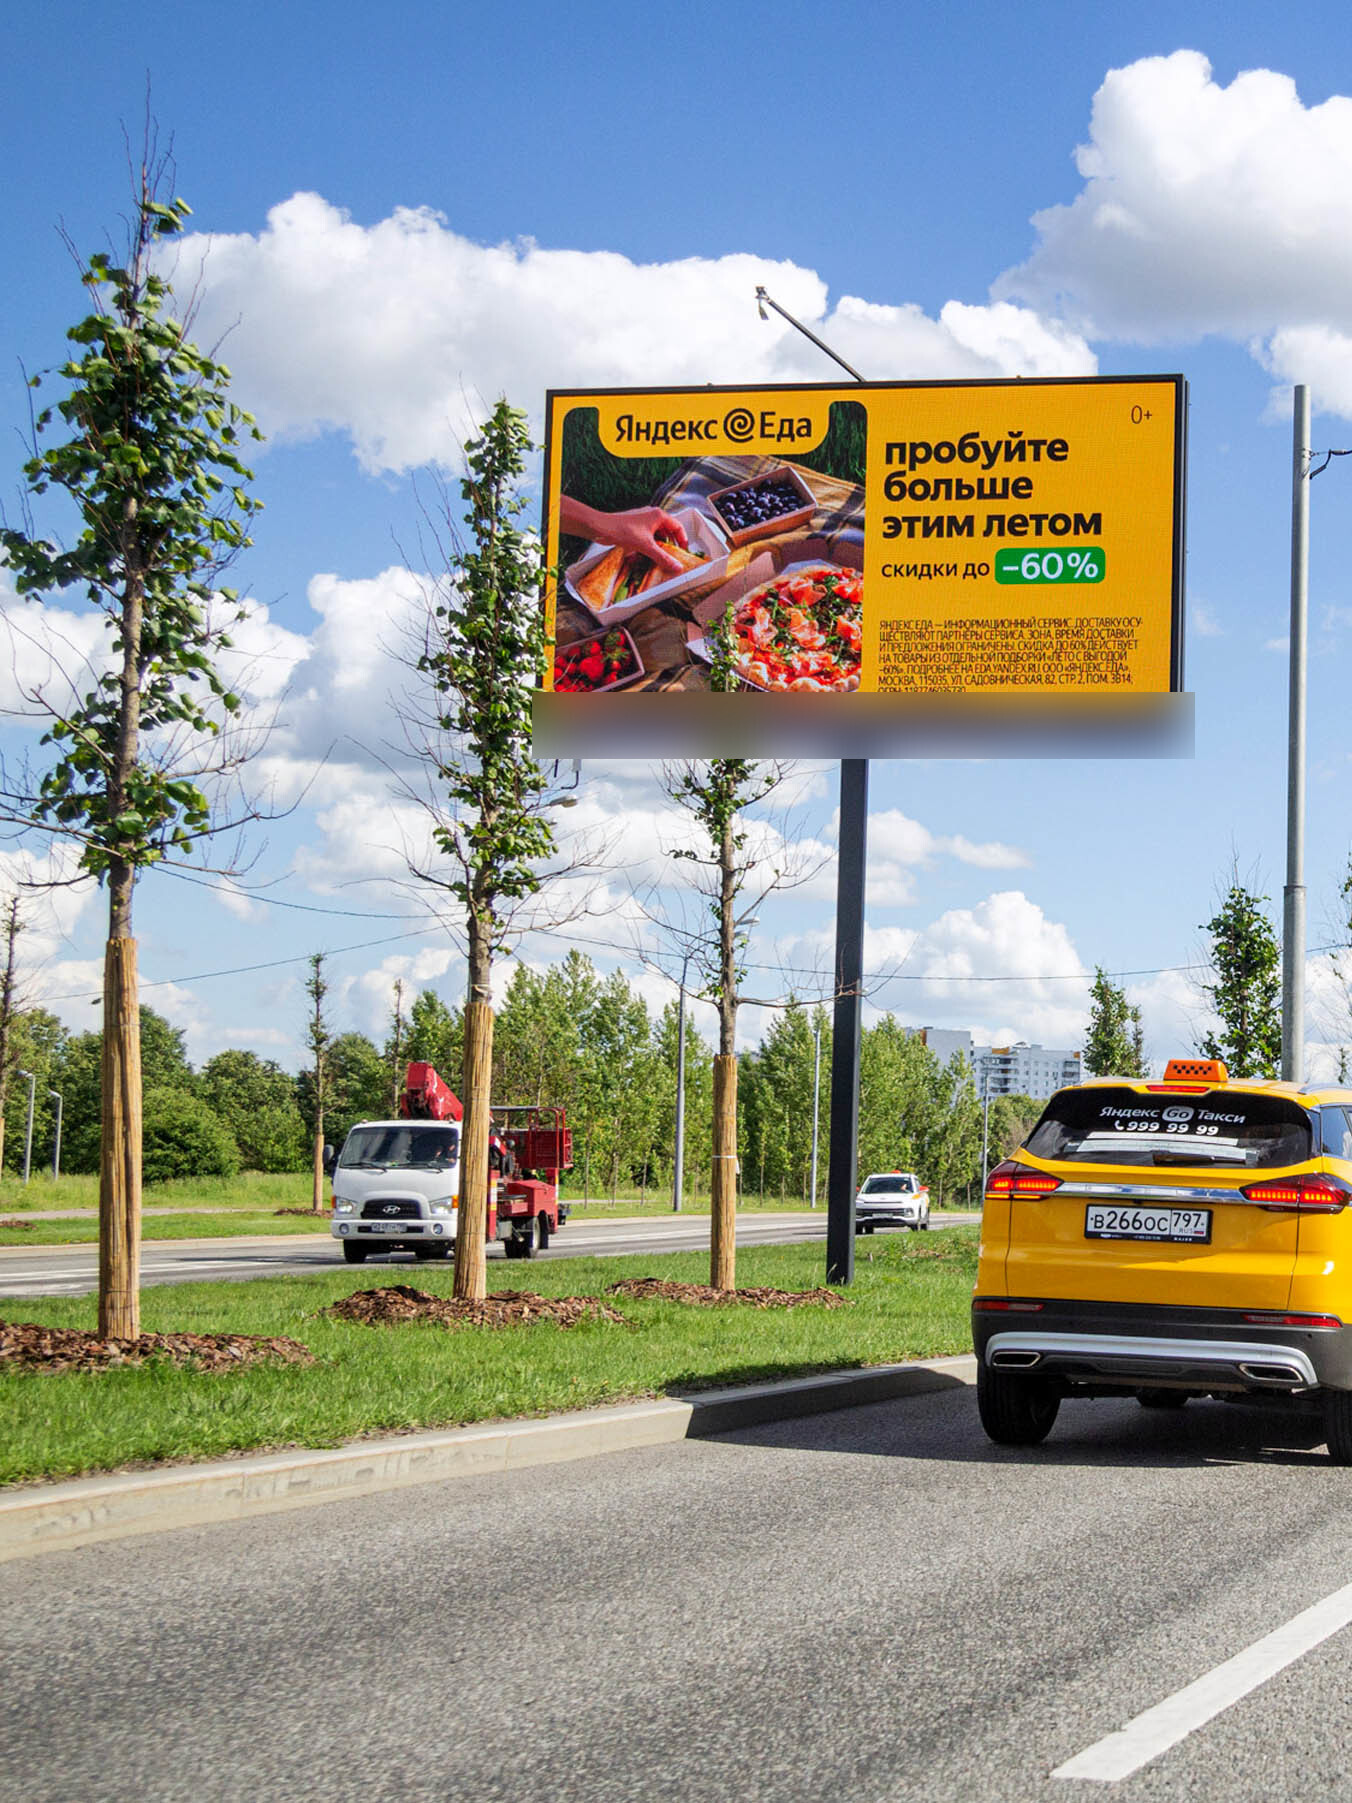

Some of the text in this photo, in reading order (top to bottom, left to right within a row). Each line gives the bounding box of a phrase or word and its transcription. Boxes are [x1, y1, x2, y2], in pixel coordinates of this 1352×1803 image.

[1131, 405, 1152, 424] 0+
[615, 411, 812, 445] Яндекс Еда
[885, 431, 1069, 471] пробуйте
[884, 471, 1033, 501] больше
[882, 512, 1102, 538] этим летом
[881, 563, 957, 580] скидки
[963, 562, 990, 580] до
[944, 616, 1035, 630] ИНФОРМАЦИОННЫЙ
[1075, 617, 1121, 629] ДОСТАВКУ
[880, 630, 935, 641] ЩЕСТВЛЯЮТ
[1055, 629, 1085, 640] ВРЕМЯ
[1086, 628, 1135, 640] ДОСТАВКИ
[887, 641, 954, 653] ПРЕДЛОЖЕНИЯ
[1018, 640, 1054, 652] СКИДКА
[1055, 640, 1068, 652] ДО
[1087, 638, 1138, 650] ДЕЙСТВУЕТ
[879, 653, 891, 663] НА
[893, 653, 928, 663] ТОВАРЫ
[930, 652, 941, 663] ИЗ
[942, 651, 995, 664] ОТДЕЛЬНОЙ
[997, 652, 1046, 663] ПОДБОРКИ
[1084, 649, 1127, 662] ВЫГОДОЙ
[907, 664, 959, 675] ПОДРОБНЕЕ
[961, 663, 973, 674] НА
[1042, 662, 1063, 673] ООО
[1099, 1106, 1246, 1123] Яндекс Go Такси
[1126, 1121, 1219, 1136] 999 99 99
[1173, 1212, 1202, 1227] 797
